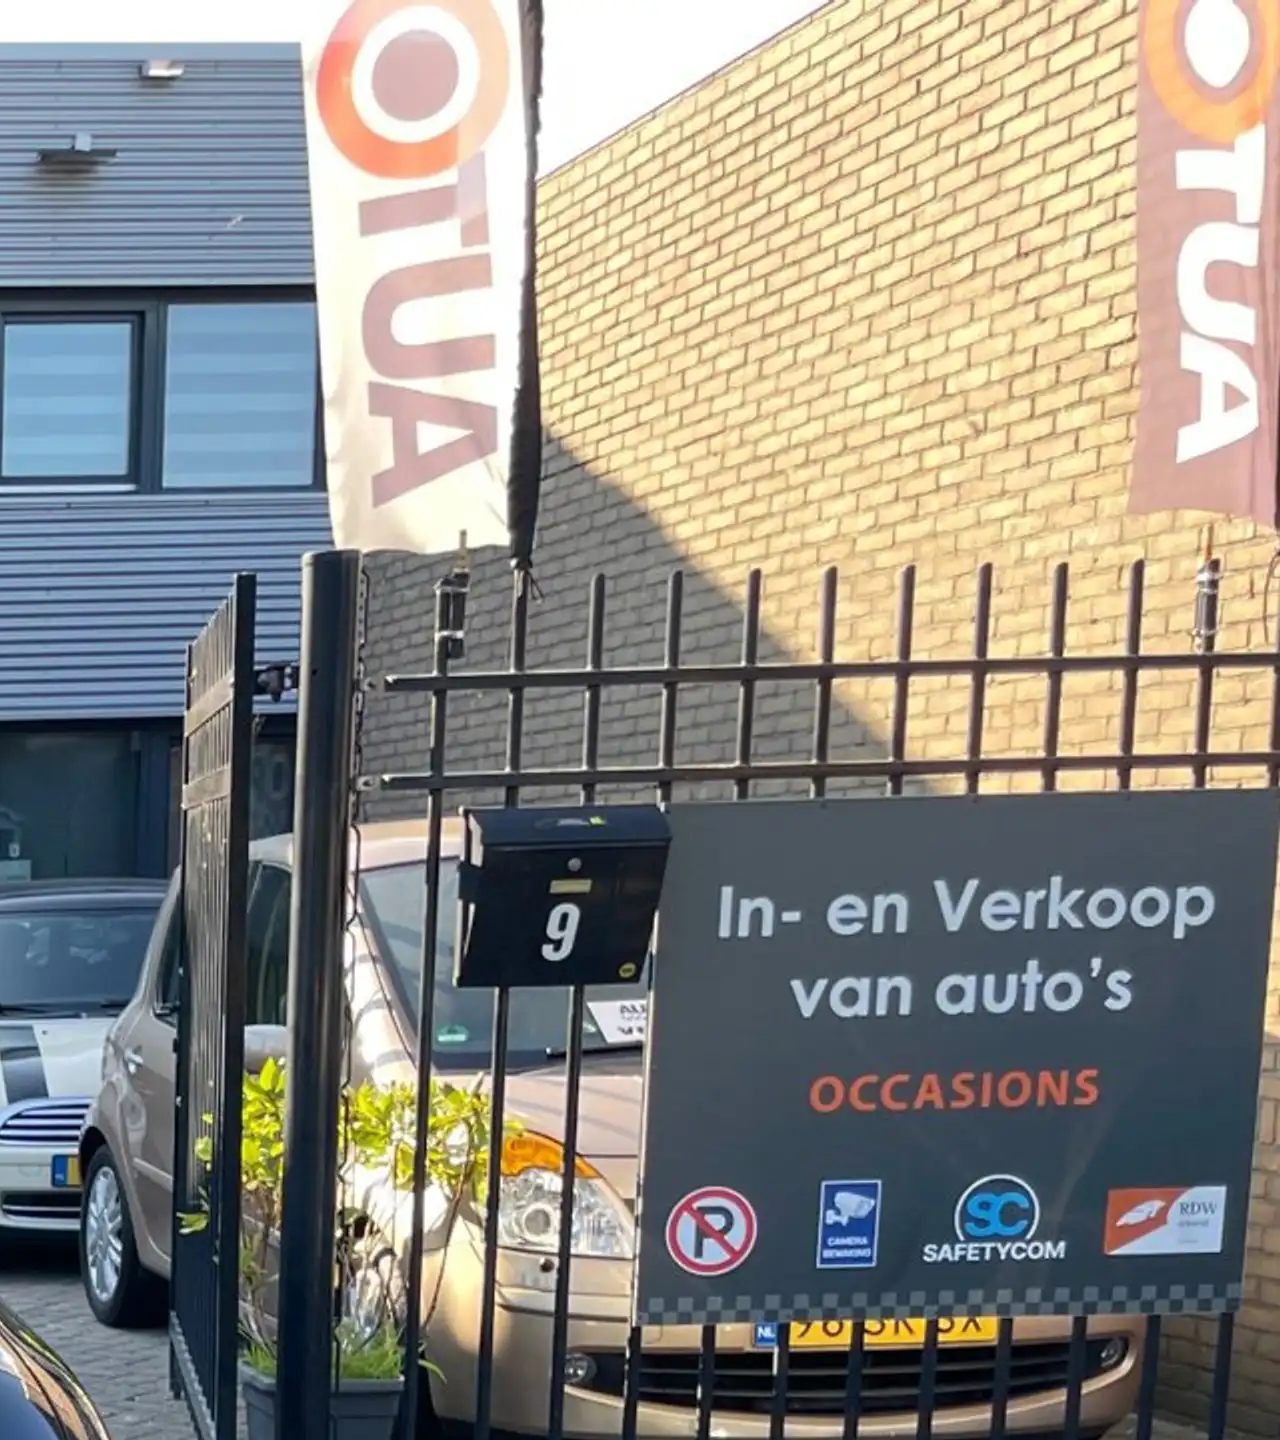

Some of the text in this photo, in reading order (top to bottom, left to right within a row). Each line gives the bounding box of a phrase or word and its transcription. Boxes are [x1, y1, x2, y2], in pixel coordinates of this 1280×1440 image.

[718, 876, 1215, 939] In- en Verkoop
[541, 902, 581, 962] 9
[790, 975, 912, 1018] van
[808, 1068, 1099, 1113] OCCASIONS
[1179, 1201, 1217, 1215] RDW
[922, 1240, 1066, 1262] SAFETYCOM
[757, 1326, 776, 1339] NL
